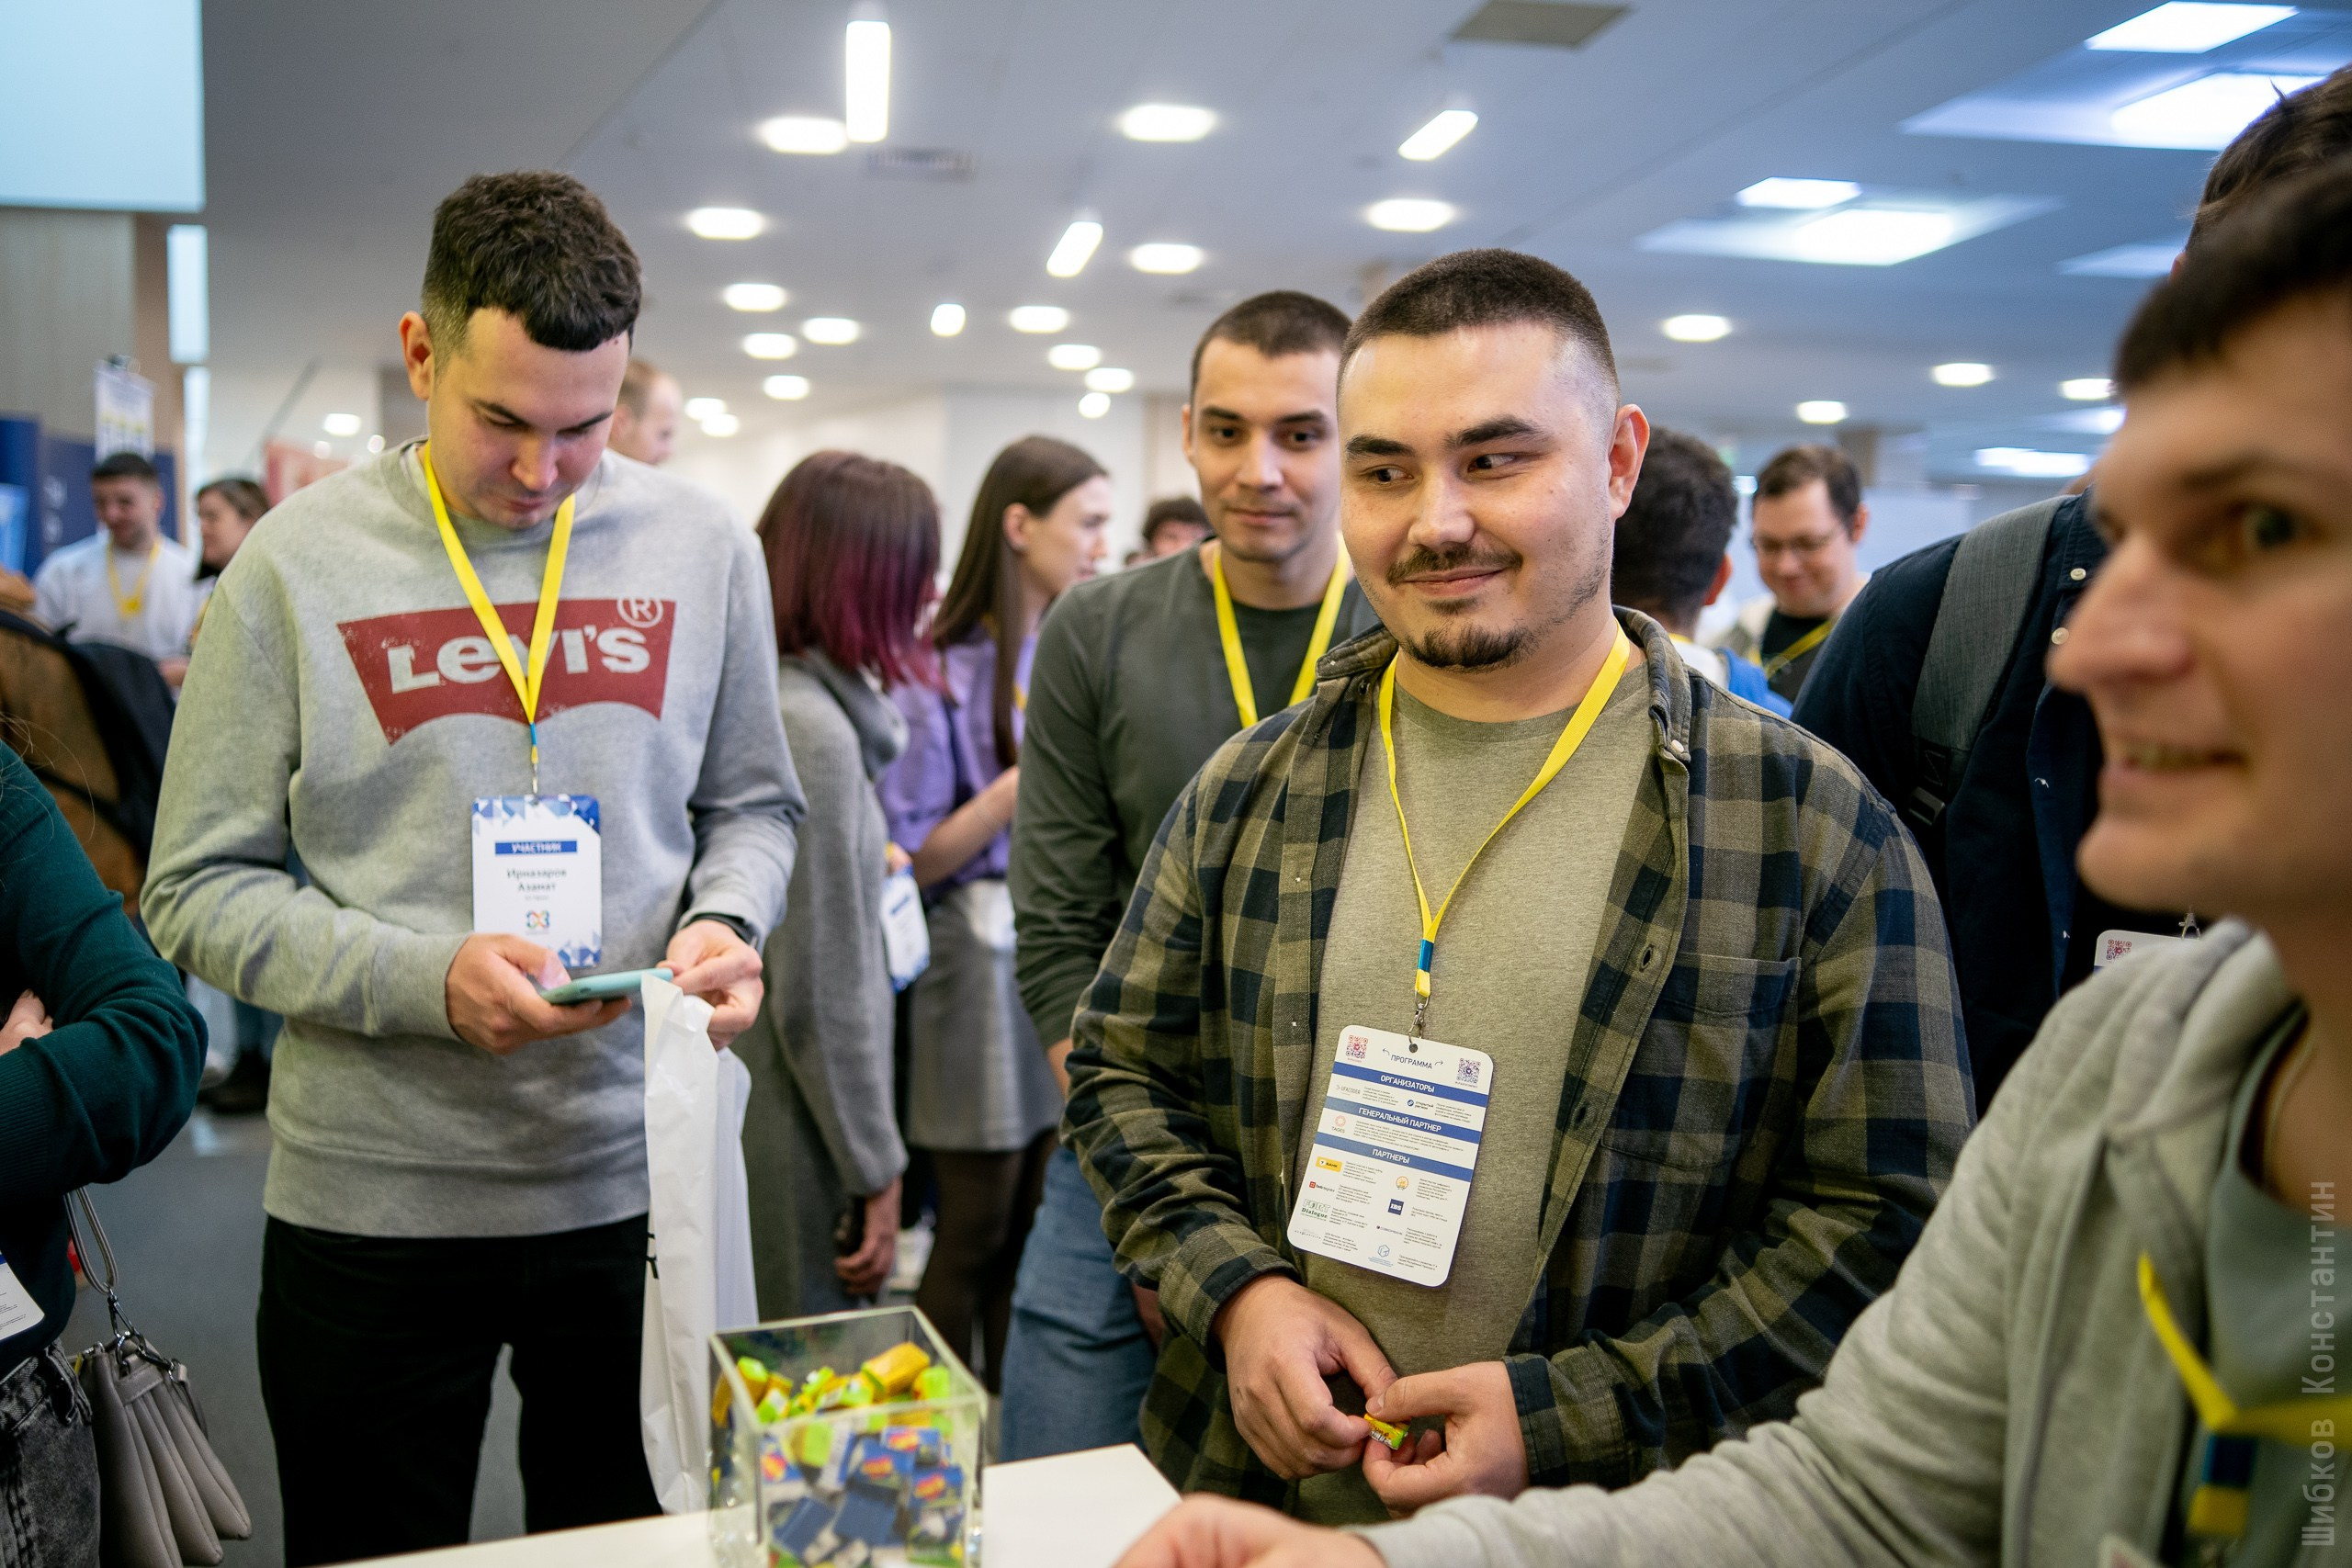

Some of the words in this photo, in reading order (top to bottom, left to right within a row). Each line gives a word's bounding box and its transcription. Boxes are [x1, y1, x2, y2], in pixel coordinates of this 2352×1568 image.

[511, 842, 561, 853] УЧАСТНИК
[518, 882, 556, 891] Азамат
[1390, 1054, 1433, 1069] ПРОГРАММА
[1380, 1075, 1435, 1093] ОРГАНИЗАТОРЫ
[1358, 1107, 1409, 1124] ГЕНЕРАЛЬНЫЙ
[1409, 1119, 1442, 1133] ПАРТНЕР
[1373, 1148, 1409, 1164] ПАРТНЕРЫ
[1301, 1207, 1328, 1218] Dialogue
